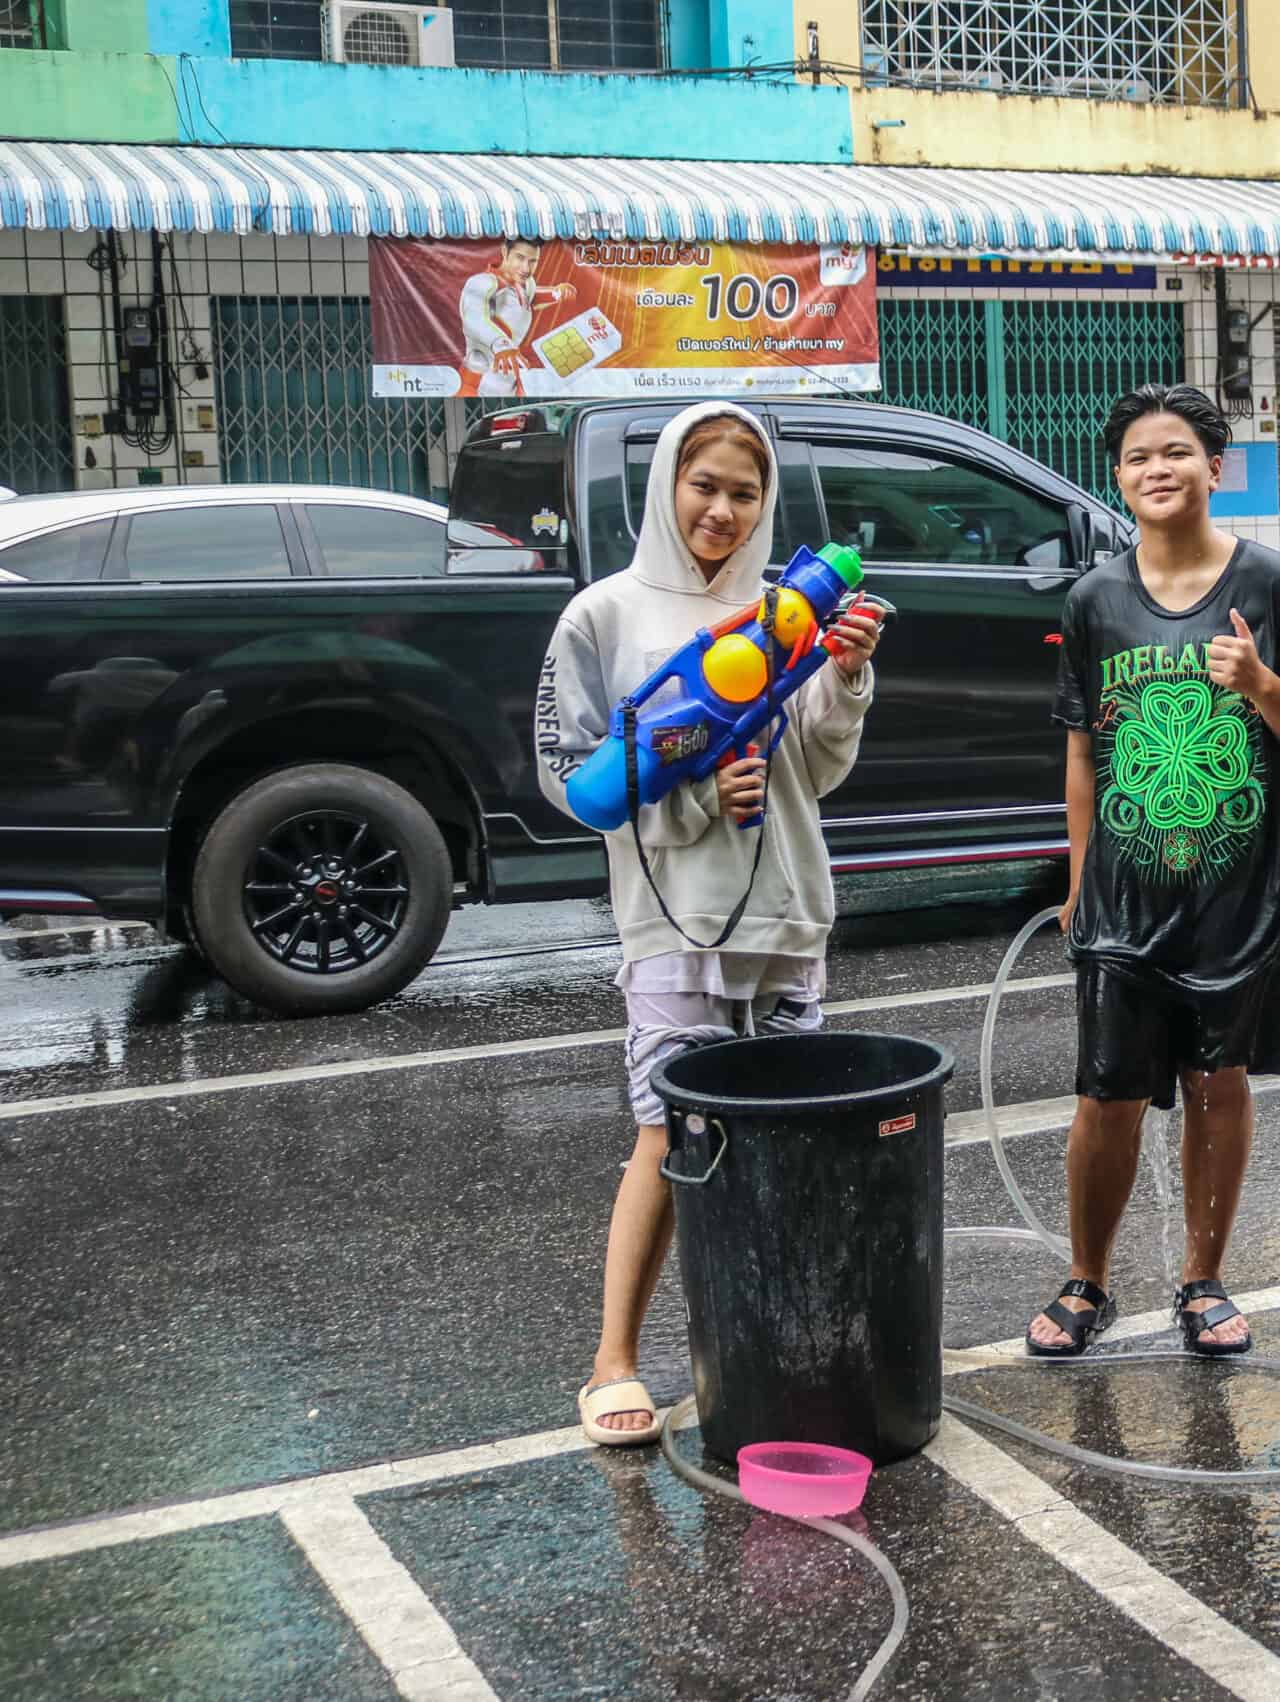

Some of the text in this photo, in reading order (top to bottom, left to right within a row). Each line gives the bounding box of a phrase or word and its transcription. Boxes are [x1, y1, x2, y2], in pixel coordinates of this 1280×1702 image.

[636, 287, 694, 306] เดือนละ
[702, 274, 798, 321] 100
[825, 338, 846, 352] my
[403, 377, 423, 393] nt
